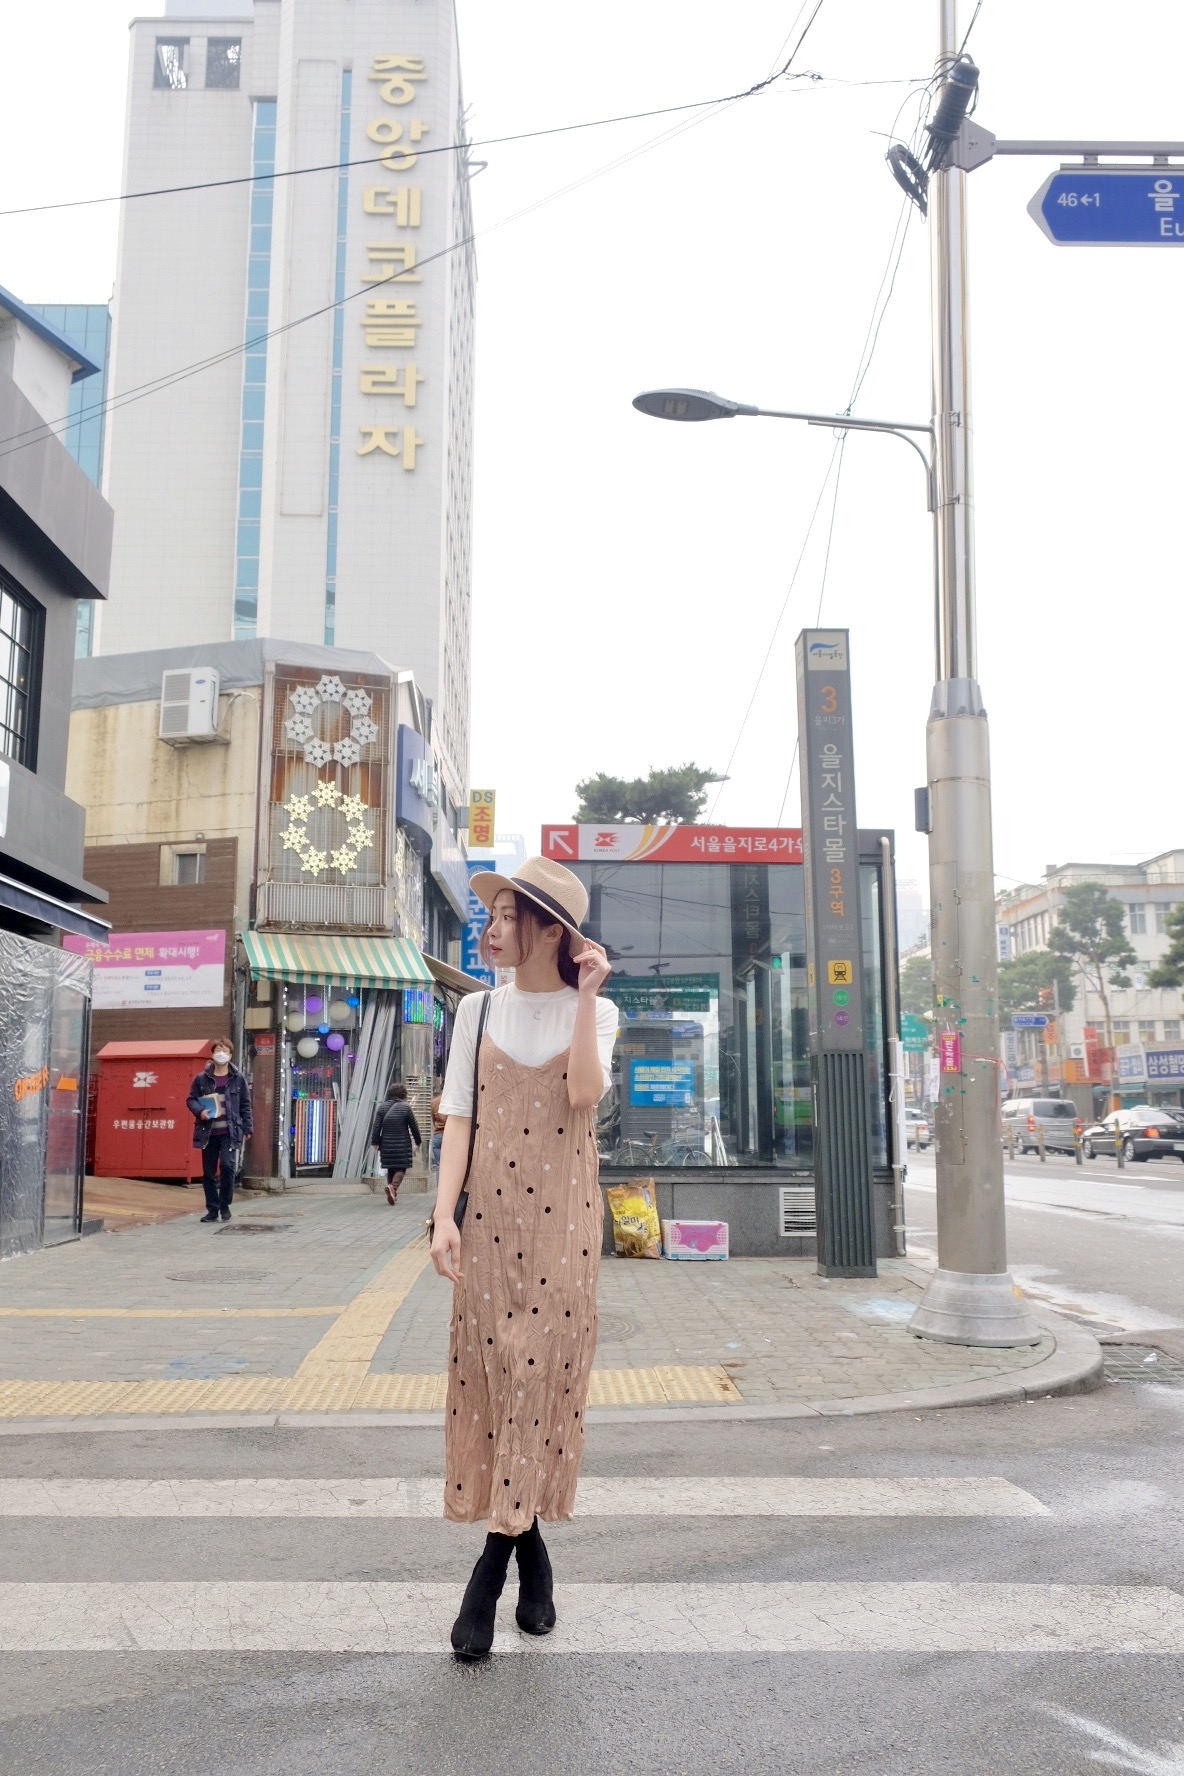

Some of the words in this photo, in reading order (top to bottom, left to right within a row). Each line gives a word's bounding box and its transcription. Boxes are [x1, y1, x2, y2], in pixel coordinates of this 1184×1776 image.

[1148, 179, 1180, 211] 을
[1160, 217, 1184, 236] Eu
[356, 55, 430, 472] 중앙데코플라자
[820, 685, 838, 713] 3
[813, 715, 846, 726] 을지3가
[472, 791, 493, 803] DS
[818, 743, 847, 863] 을지스타몰
[472, 806, 492, 843] 조명
[828, 868, 845, 917] 3구역
[134, 946, 154, 960] 면제
[158, 946, 200, 960] 확대시행!
[113, 1119, 175, 1130] 우편물중간보관함
